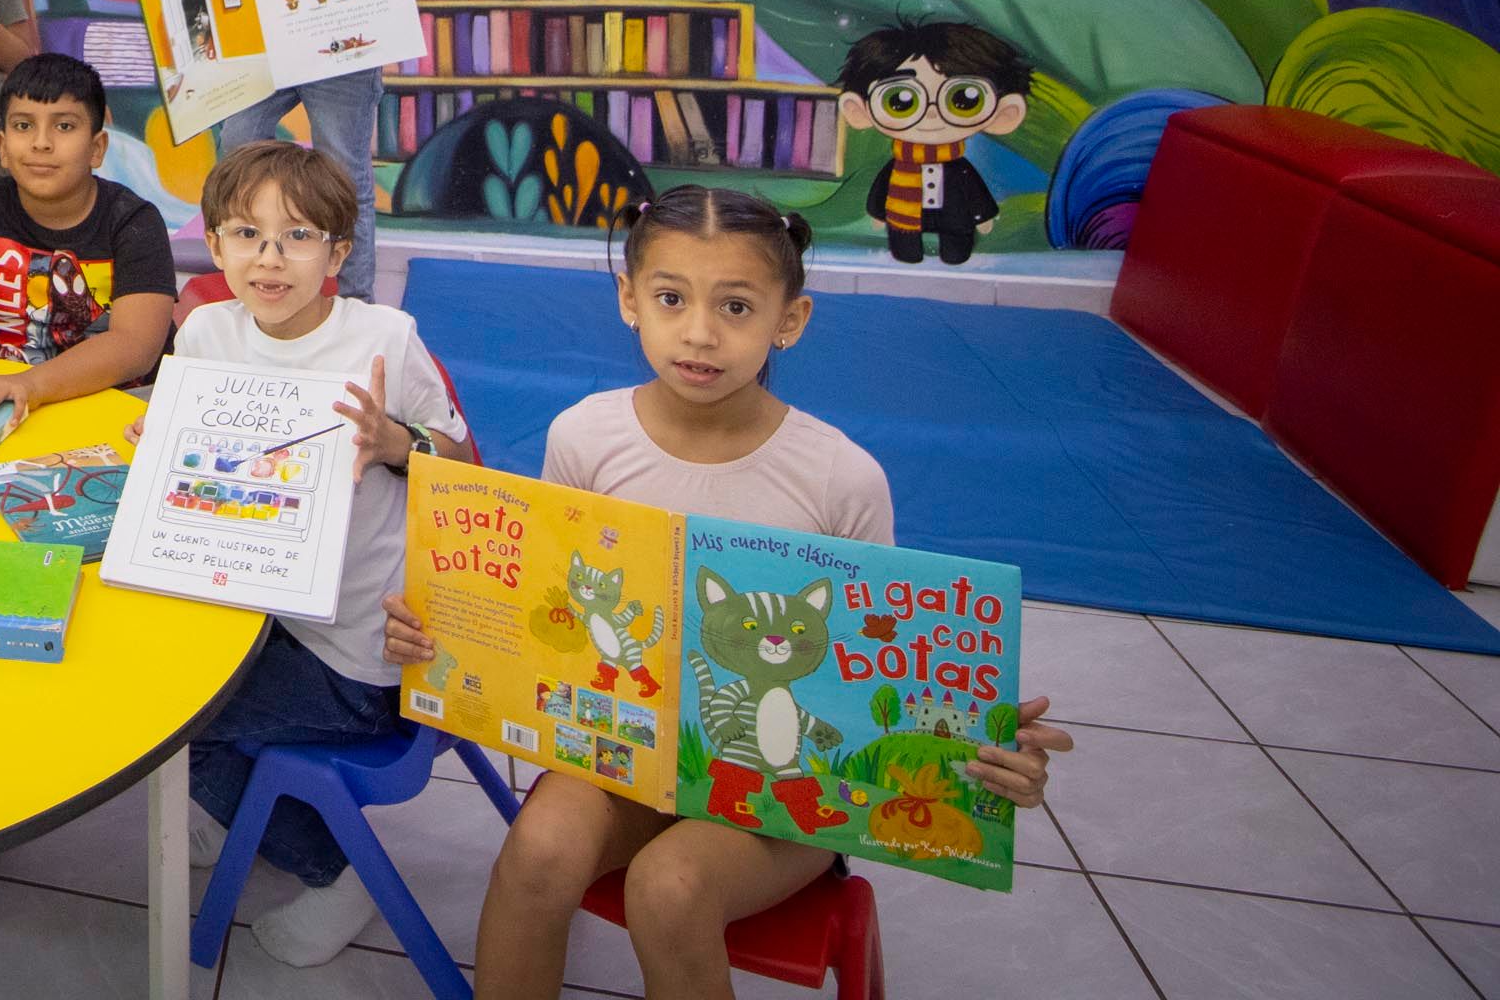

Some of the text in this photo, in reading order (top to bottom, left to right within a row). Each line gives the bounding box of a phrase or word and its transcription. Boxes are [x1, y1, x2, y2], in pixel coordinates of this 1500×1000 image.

[215, 376, 300, 400] JULIETA
[196, 395, 314, 417] Y SU CAJA DE
[201, 408, 297, 436] COLORES
[431, 483, 530, 512] Mis cuentos clásicos
[52, 514, 114, 532] Muert
[433, 506, 524, 541] El gato
[152, 530, 299, 560] UN CUENTO ILUSTRADO DE
[486, 539, 522, 558] con
[691, 533, 860, 579] Mis cuentos clásicos
[152, 547, 289, 578] CARLOS PELLICER LÓPEZ
[431, 545, 522, 589] botas
[844, 576, 1003, 627] El gato
[932, 624, 1003, 656] con
[833, 634, 1002, 702] botas
[859, 834, 901, 848] Ilustrado
[903, 842, 919, 851] por
[920, 840, 942, 858] Kay
